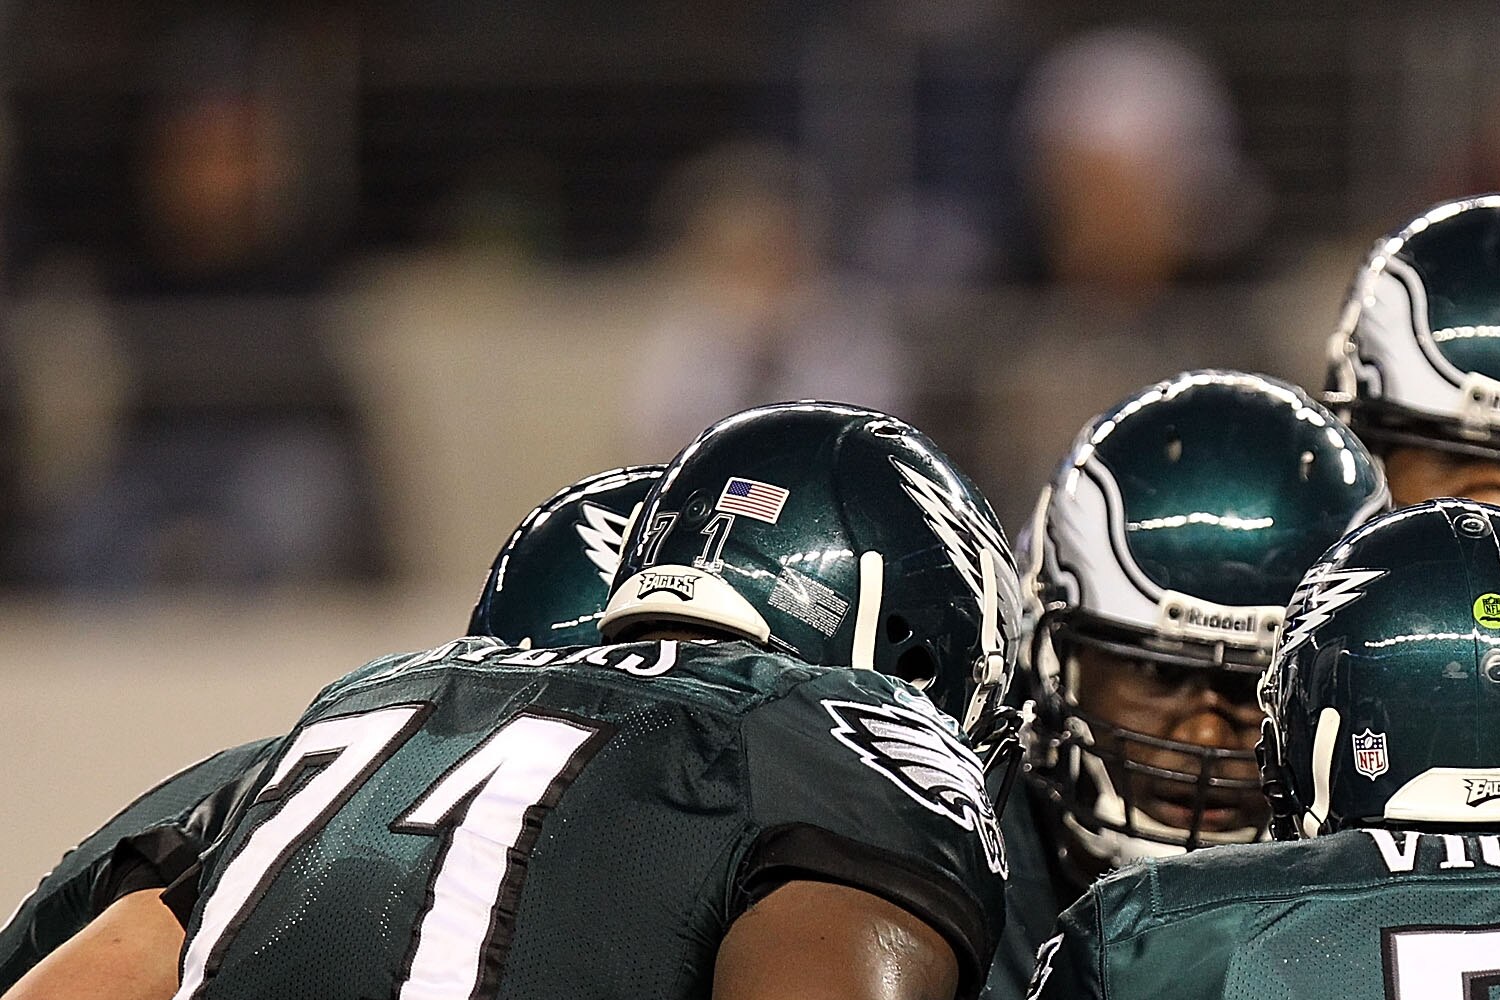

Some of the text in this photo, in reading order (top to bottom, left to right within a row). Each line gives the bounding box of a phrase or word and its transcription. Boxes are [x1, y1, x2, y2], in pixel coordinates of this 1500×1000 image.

[643, 511, 735, 572] 71
[637, 573, 703, 601] EAGLES
[1485, 604, 1500, 614] NFL
[1359, 751, 1384, 771] NFL
